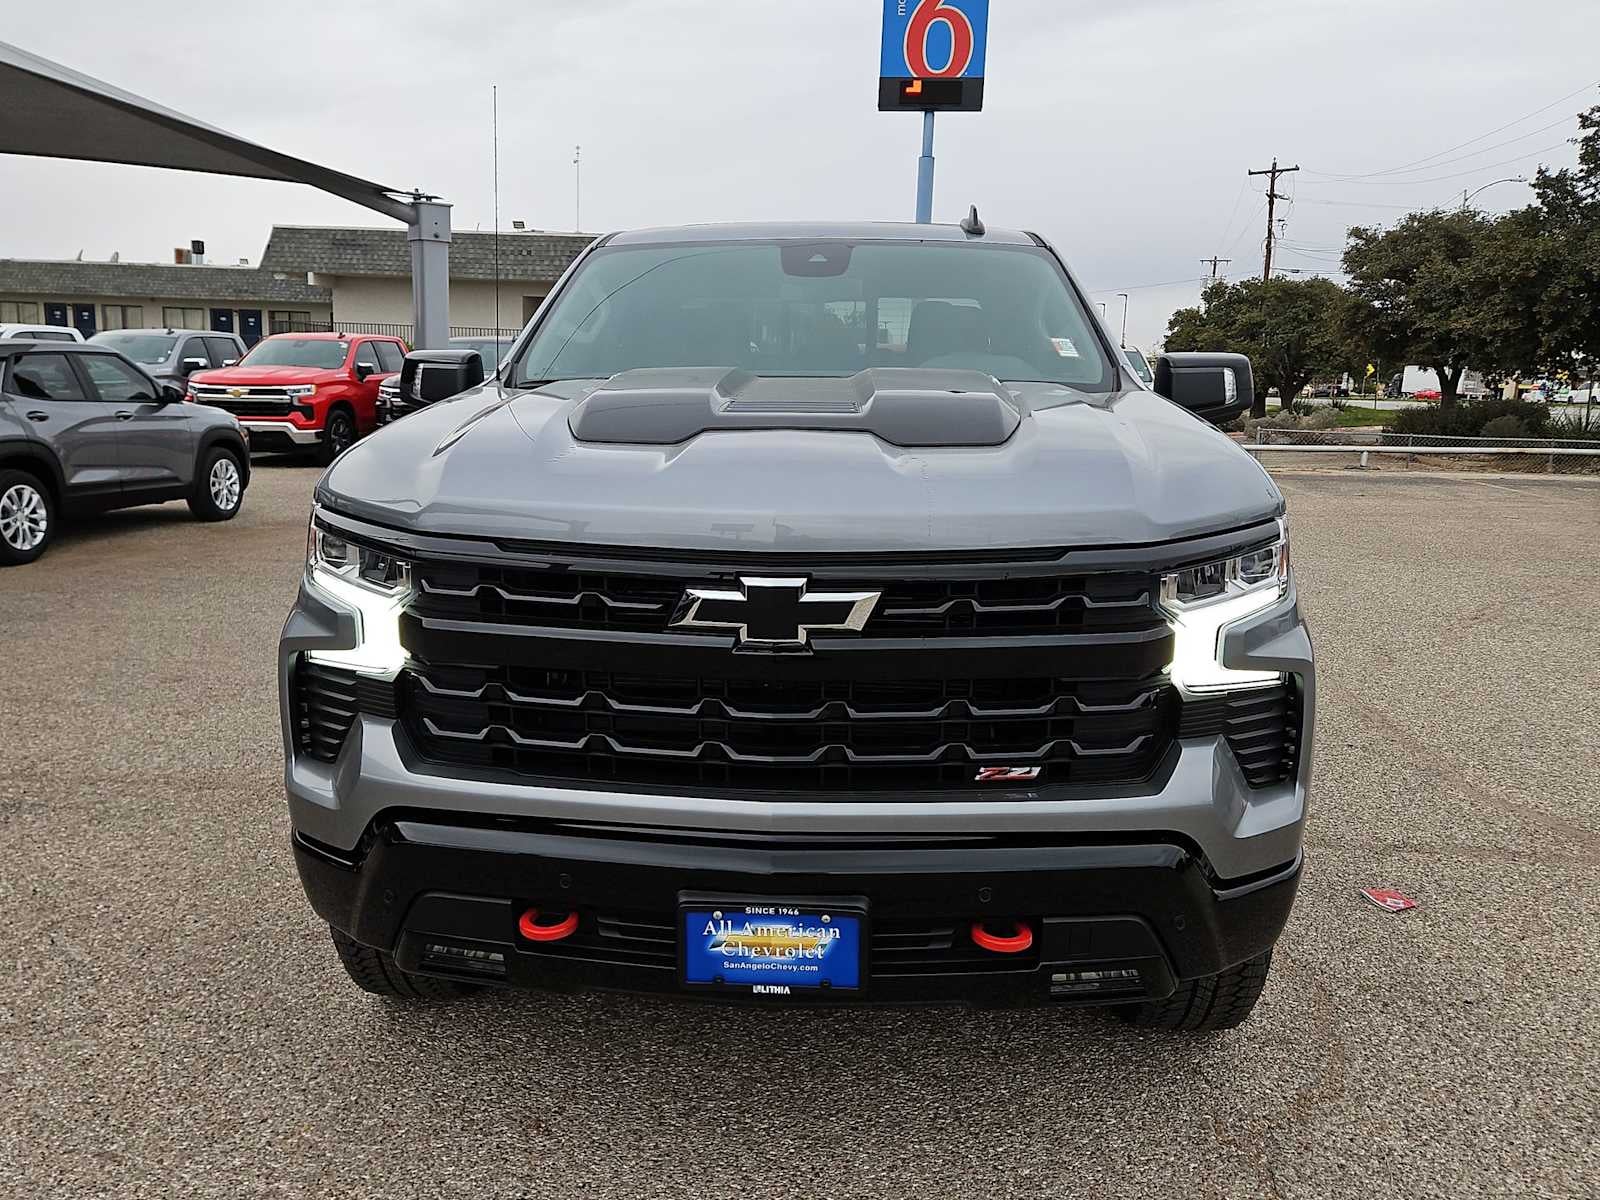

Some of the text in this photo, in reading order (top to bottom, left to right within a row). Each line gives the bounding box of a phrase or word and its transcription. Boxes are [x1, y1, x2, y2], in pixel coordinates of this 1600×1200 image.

[903, 0, 974, 77] 6
[974, 766, 1041, 780] Z71
[745, 906, 800, 916] SINCE 1946
[702, 920, 841, 939] All American
[721, 940, 825, 960] Chevrolet
[723, 961, 819, 972] SanAngeloChevy.com
